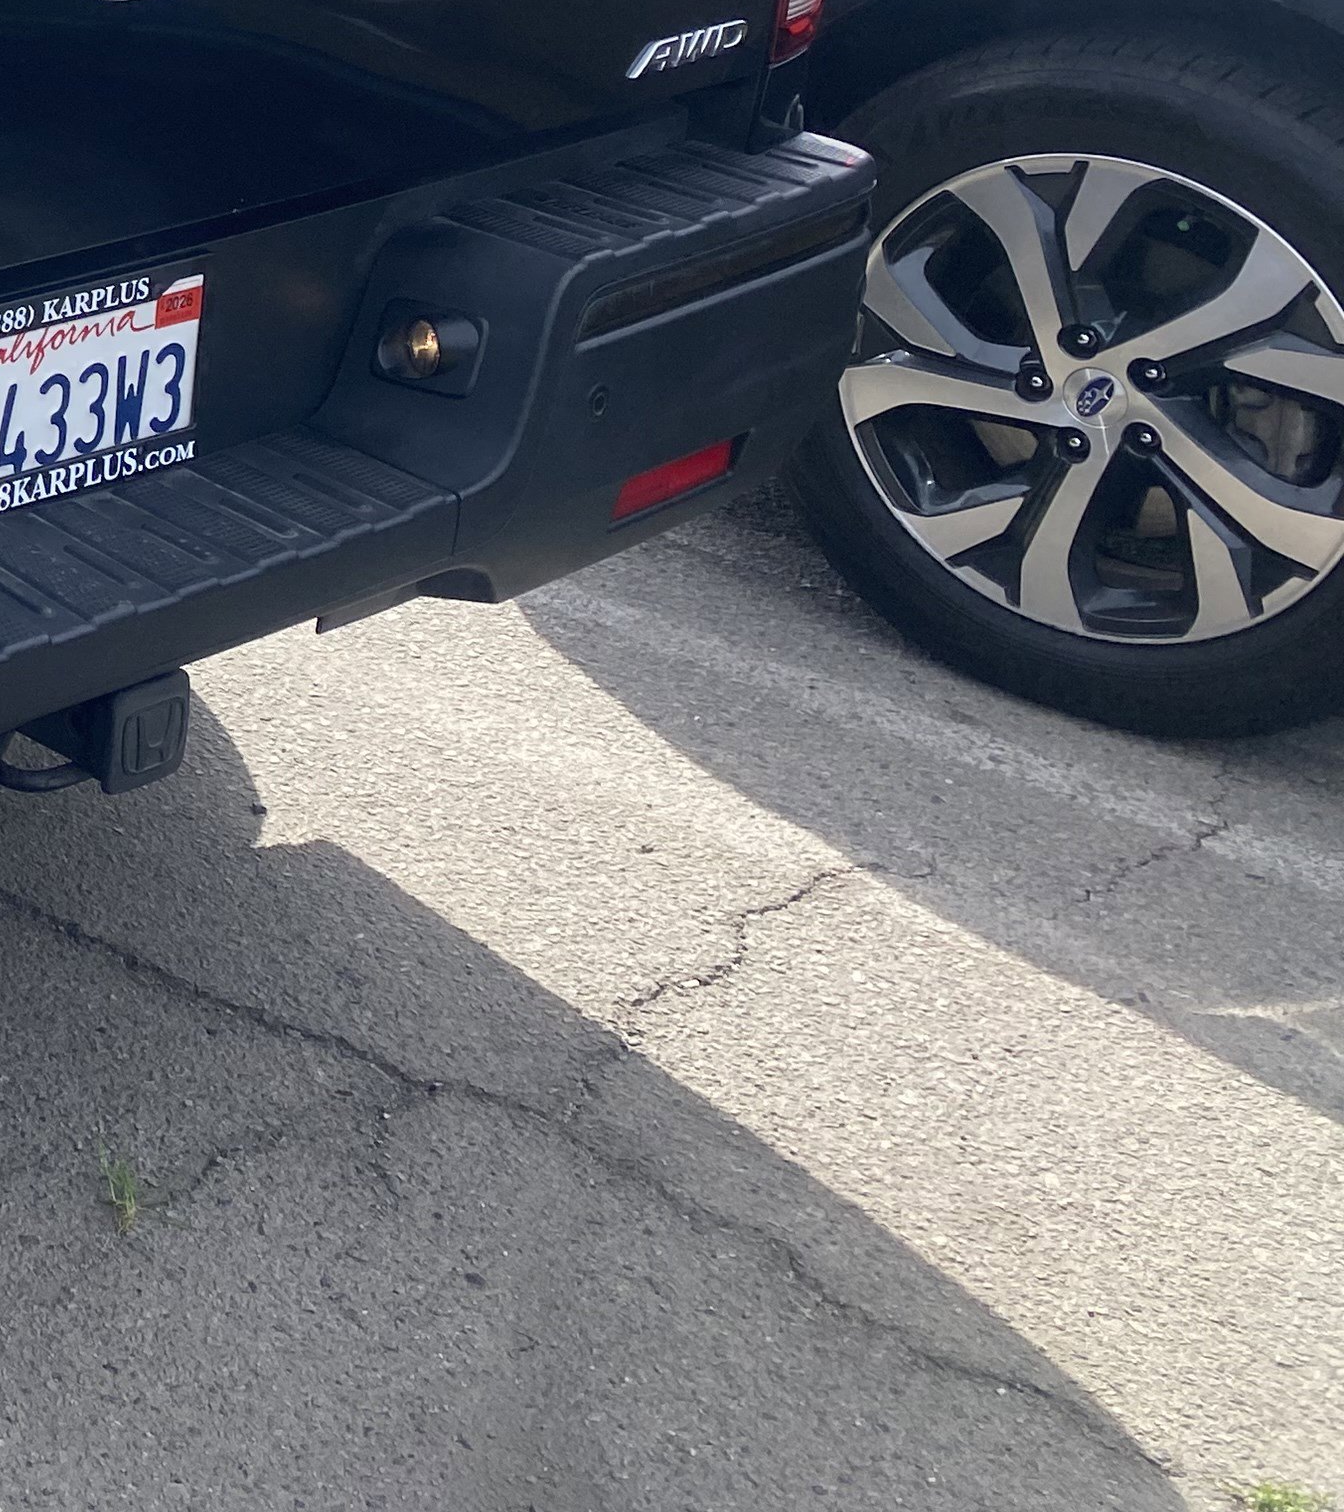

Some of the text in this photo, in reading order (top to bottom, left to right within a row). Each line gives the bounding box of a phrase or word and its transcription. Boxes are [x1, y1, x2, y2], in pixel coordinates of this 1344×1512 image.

[625, 19, 748, 79] AWD
[41, 277, 150, 323] KARPLUS
[165, 293, 193, 312] 2026
